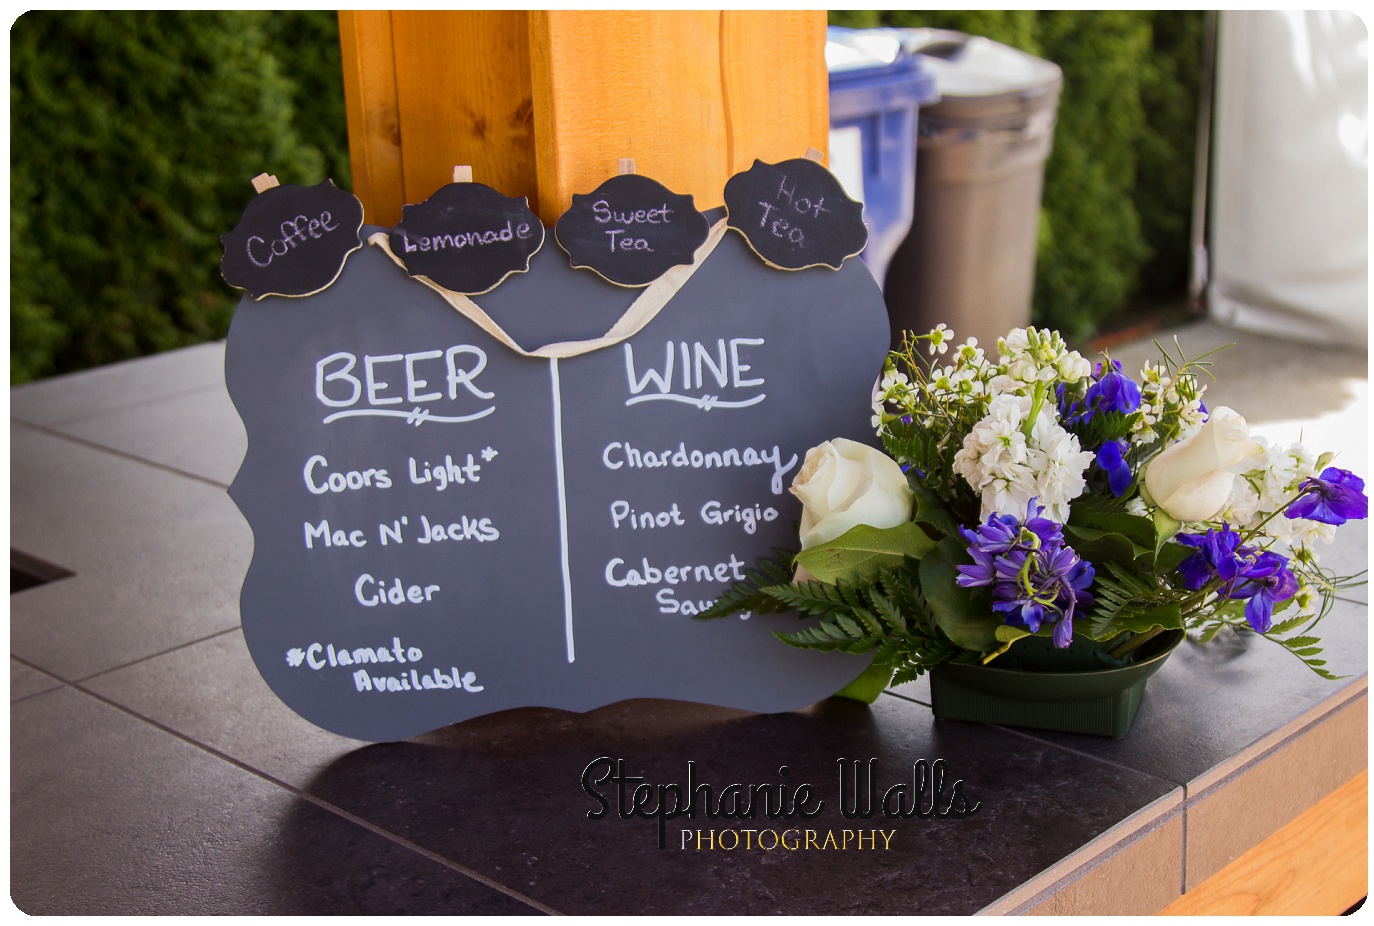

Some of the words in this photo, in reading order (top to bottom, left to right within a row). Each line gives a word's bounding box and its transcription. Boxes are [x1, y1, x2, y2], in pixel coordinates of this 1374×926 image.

[592, 200, 672, 225] Sweet
[776, 175, 832, 218] Hot
[245, 210, 340, 268] Coffee
[403, 219, 533, 252] Lemonade
[605, 229, 655, 253] Tea
[758, 200, 807, 249] Tea
[315, 344, 496, 407] BEER
[624, 338, 765, 394] WINE
[303, 454, 393, 495] Coors
[602, 441, 799, 495] Chardonnay
[304, 519, 367, 549] Mac
[379, 515, 408, 546] N'
[417, 515, 500, 544] Jacks
[610, 500, 686, 530] Pinot
[701, 500, 780, 535] Grigio
[604, 553, 747, 588] Cabernet
[354, 573, 441, 607] Cider
[353, 666, 485, 693] Available
